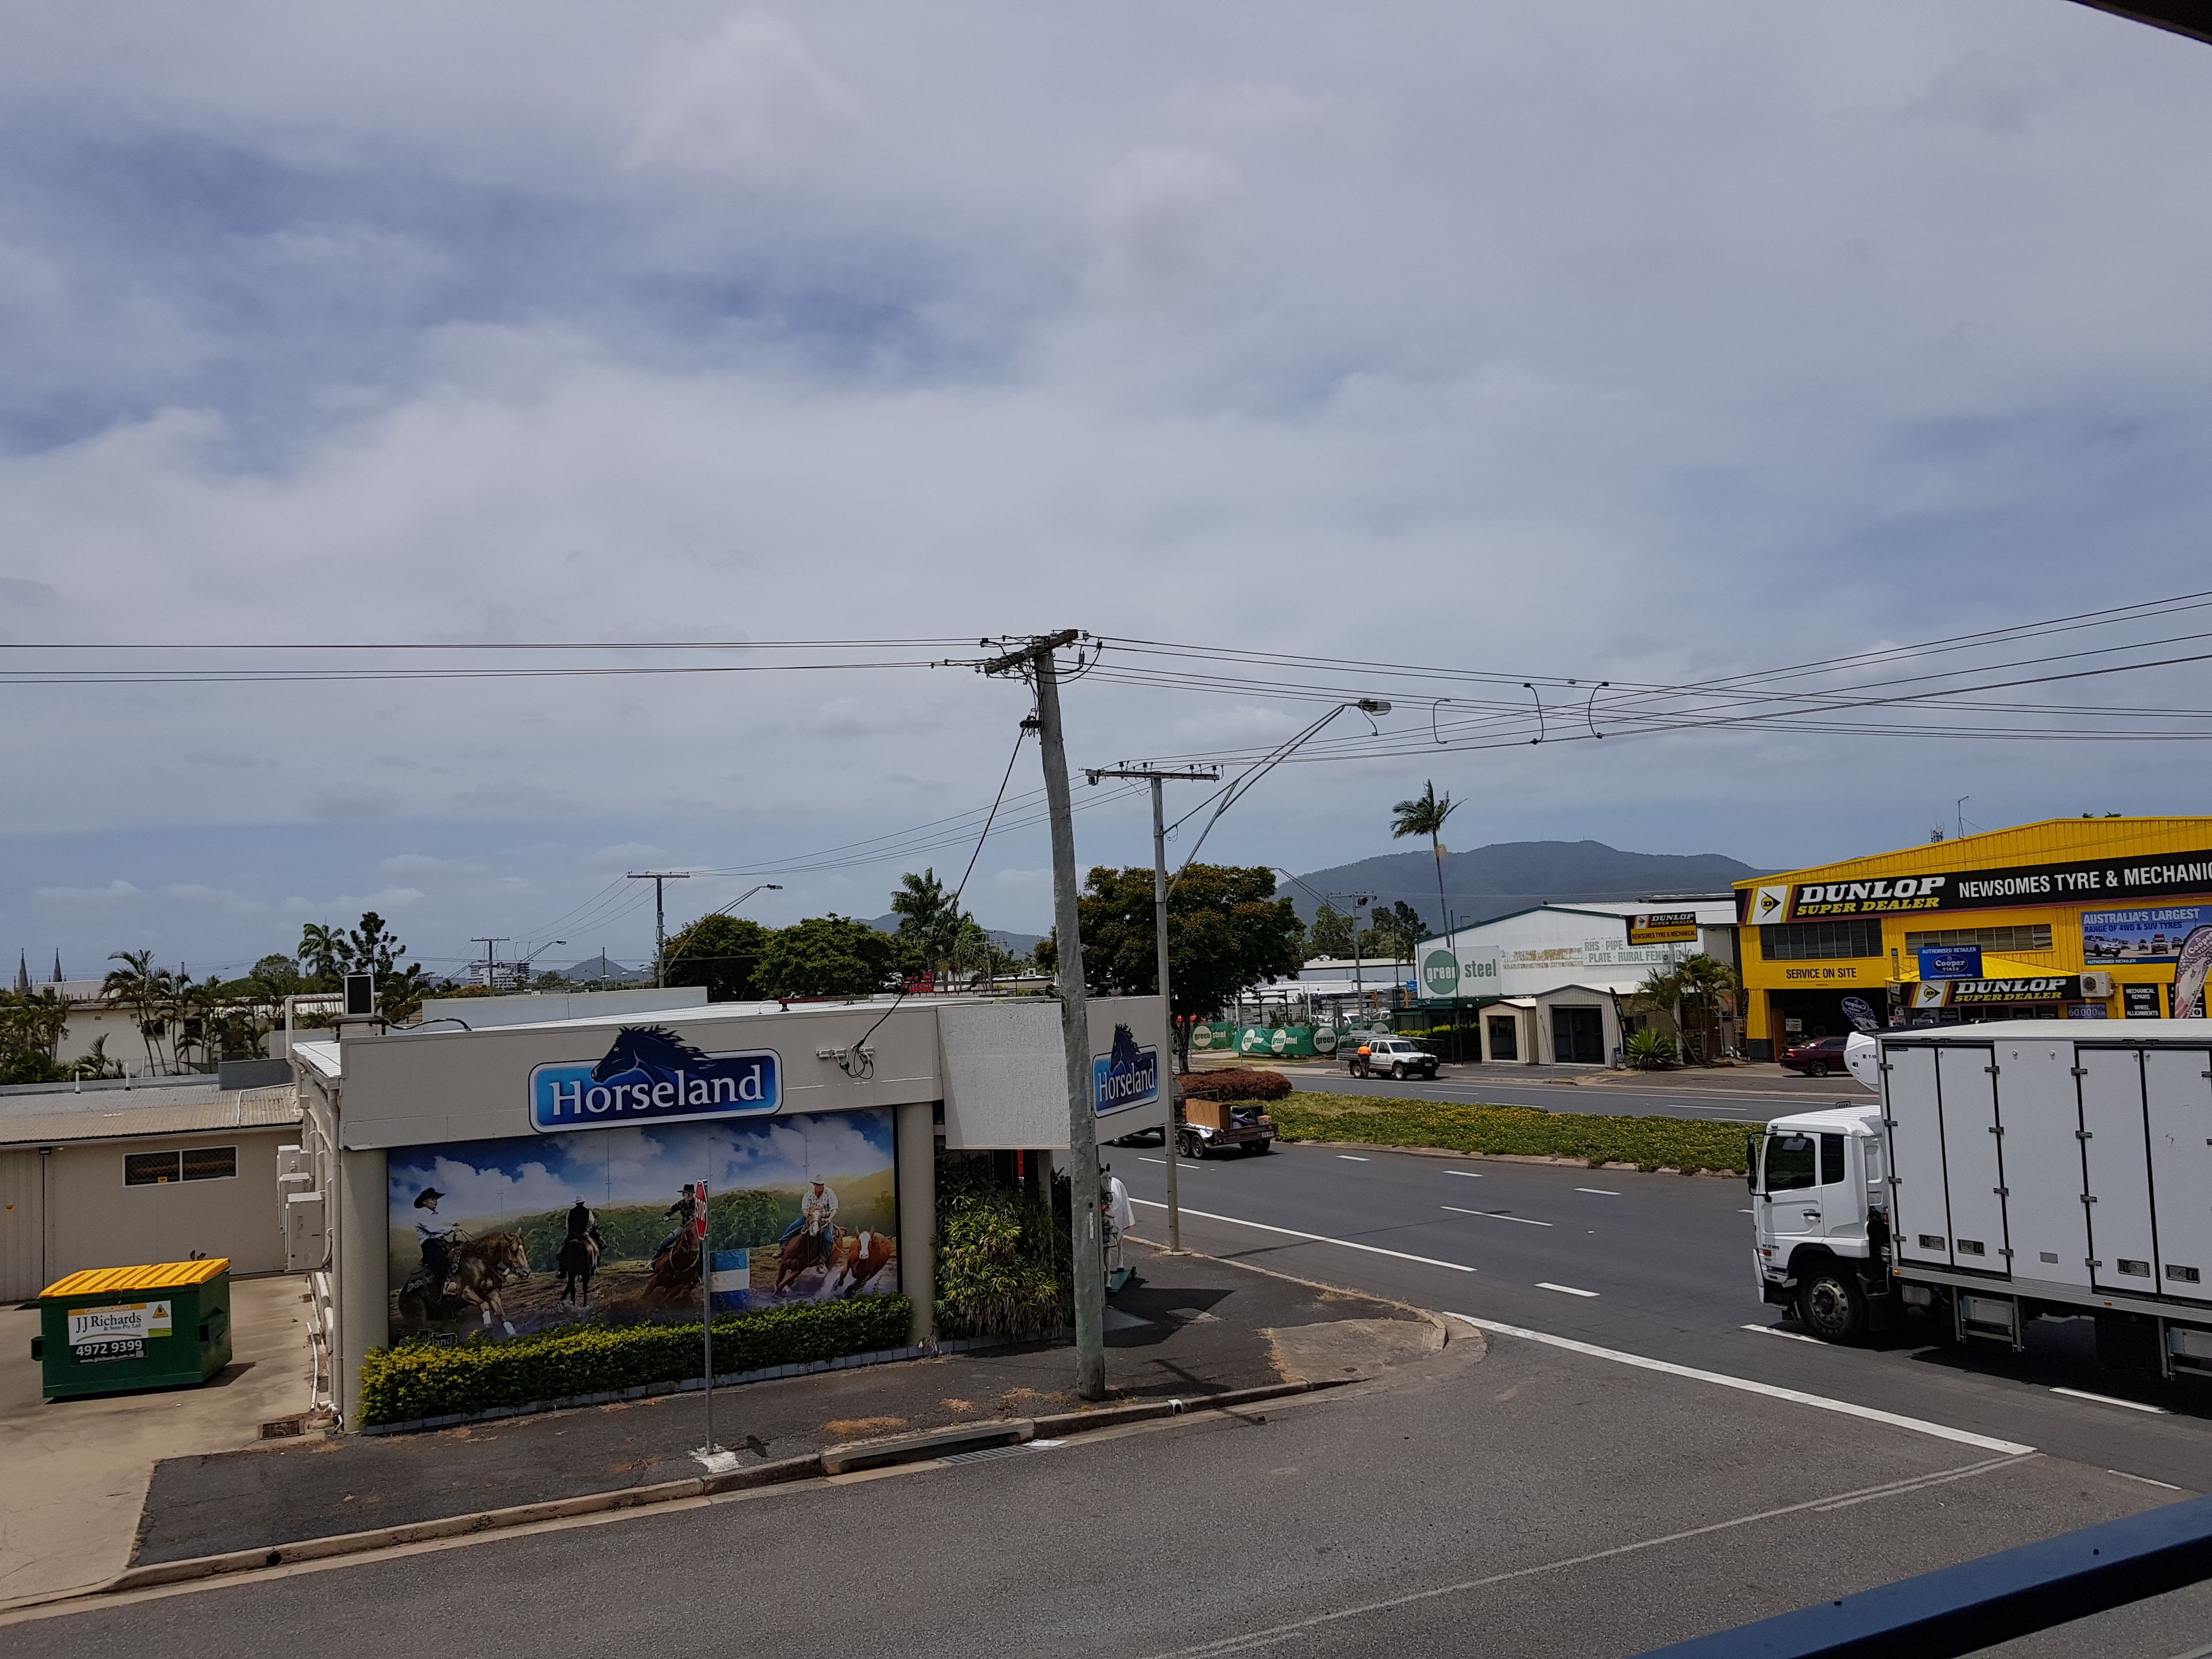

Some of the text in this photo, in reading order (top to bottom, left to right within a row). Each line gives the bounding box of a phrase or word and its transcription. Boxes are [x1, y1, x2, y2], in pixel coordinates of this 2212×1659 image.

[1800, 877, 1946, 903] DUNLOP
[1959, 875, 2050, 898] NEWSOMES
[2054, 872, 2100, 891] TYRE
[2105, 870, 2119, 887] &
[1796, 897, 1940, 916] SUPER DEALER
[1652, 914, 1694, 922] DUNLOP
[2083, 908, 2200, 925] AUSTRALIA'S LARGEST
[1584, 941, 1599, 951] RHS
[1605, 940, 1623, 950] PIPE
[1589, 952, 1612, 963] PLATE
[1618, 950, 1644, 961] RURAL
[1464, 959, 1497, 978] steel
[1786, 968, 1857, 978] SERVICE ON SITE
[1956, 979, 2066, 994] DUNLOP
[1955, 992, 2062, 1002] SUPER DEALER
[1195, 1032, 1210, 1040] green
[1316, 1036, 1335, 1045] green
[1097, 1059, 1156, 1102] Horseland
[548, 1064, 764, 1116] Horseland
[695, 1198, 706, 1221] STOP
[91, 1312, 141, 1328] Richards
[75, 1340, 142, 1357] 4972 9399
